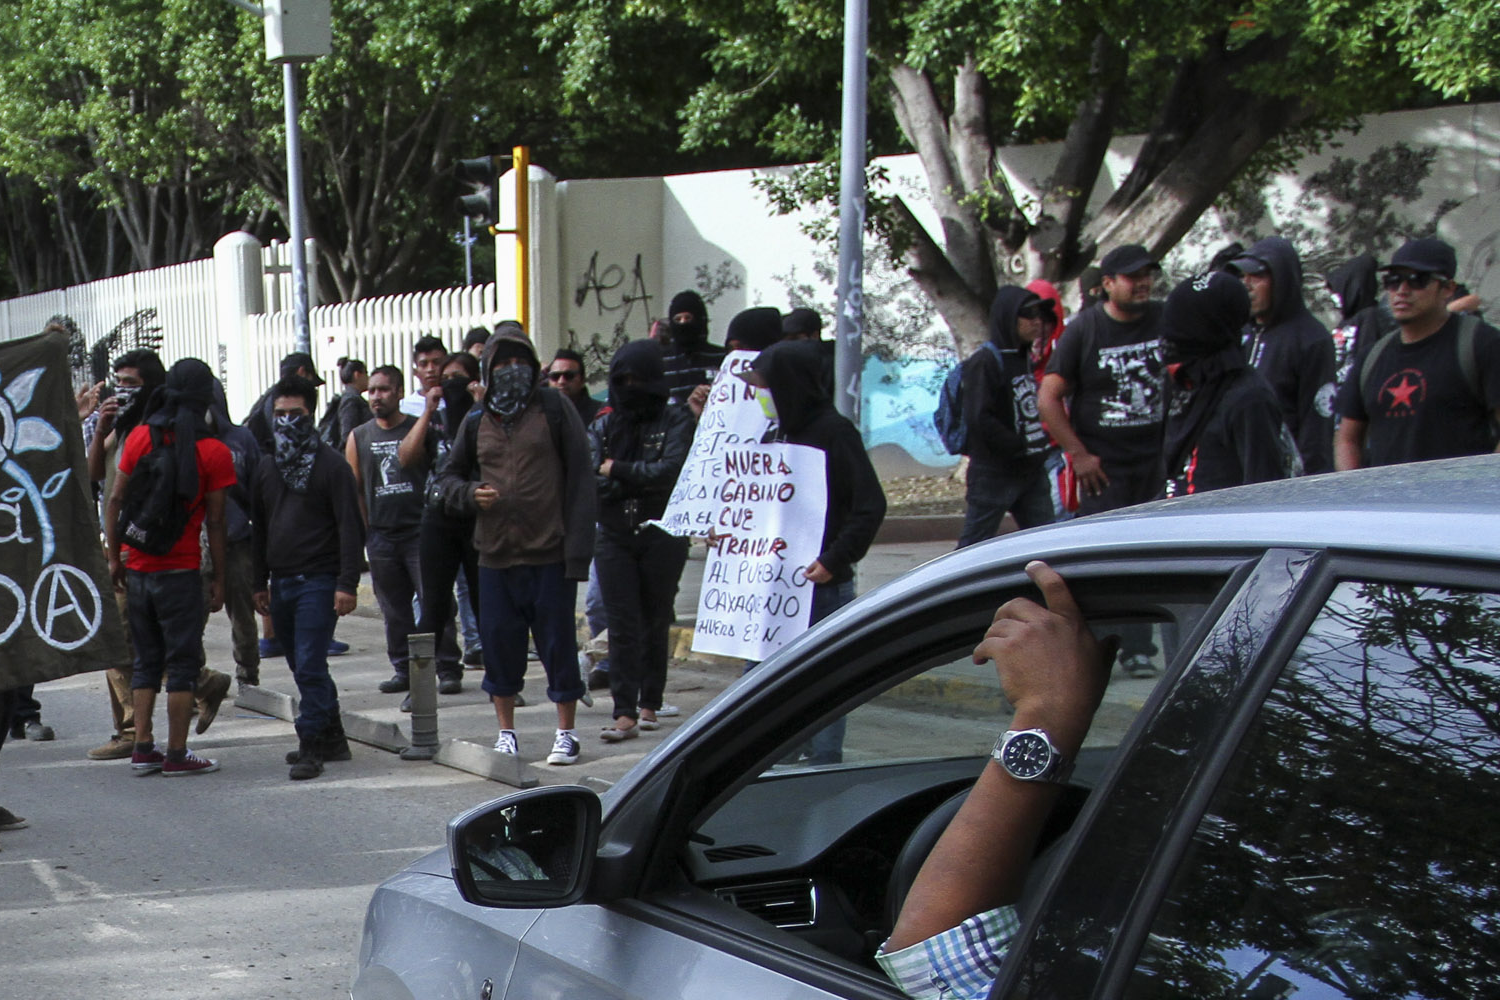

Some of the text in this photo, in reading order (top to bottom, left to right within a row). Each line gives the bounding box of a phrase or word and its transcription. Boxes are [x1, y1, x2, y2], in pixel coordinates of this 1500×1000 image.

[725, 450, 793, 478] MUERA
[720, 477, 795, 504] GABINO
[708, 560, 729, 585] AL
